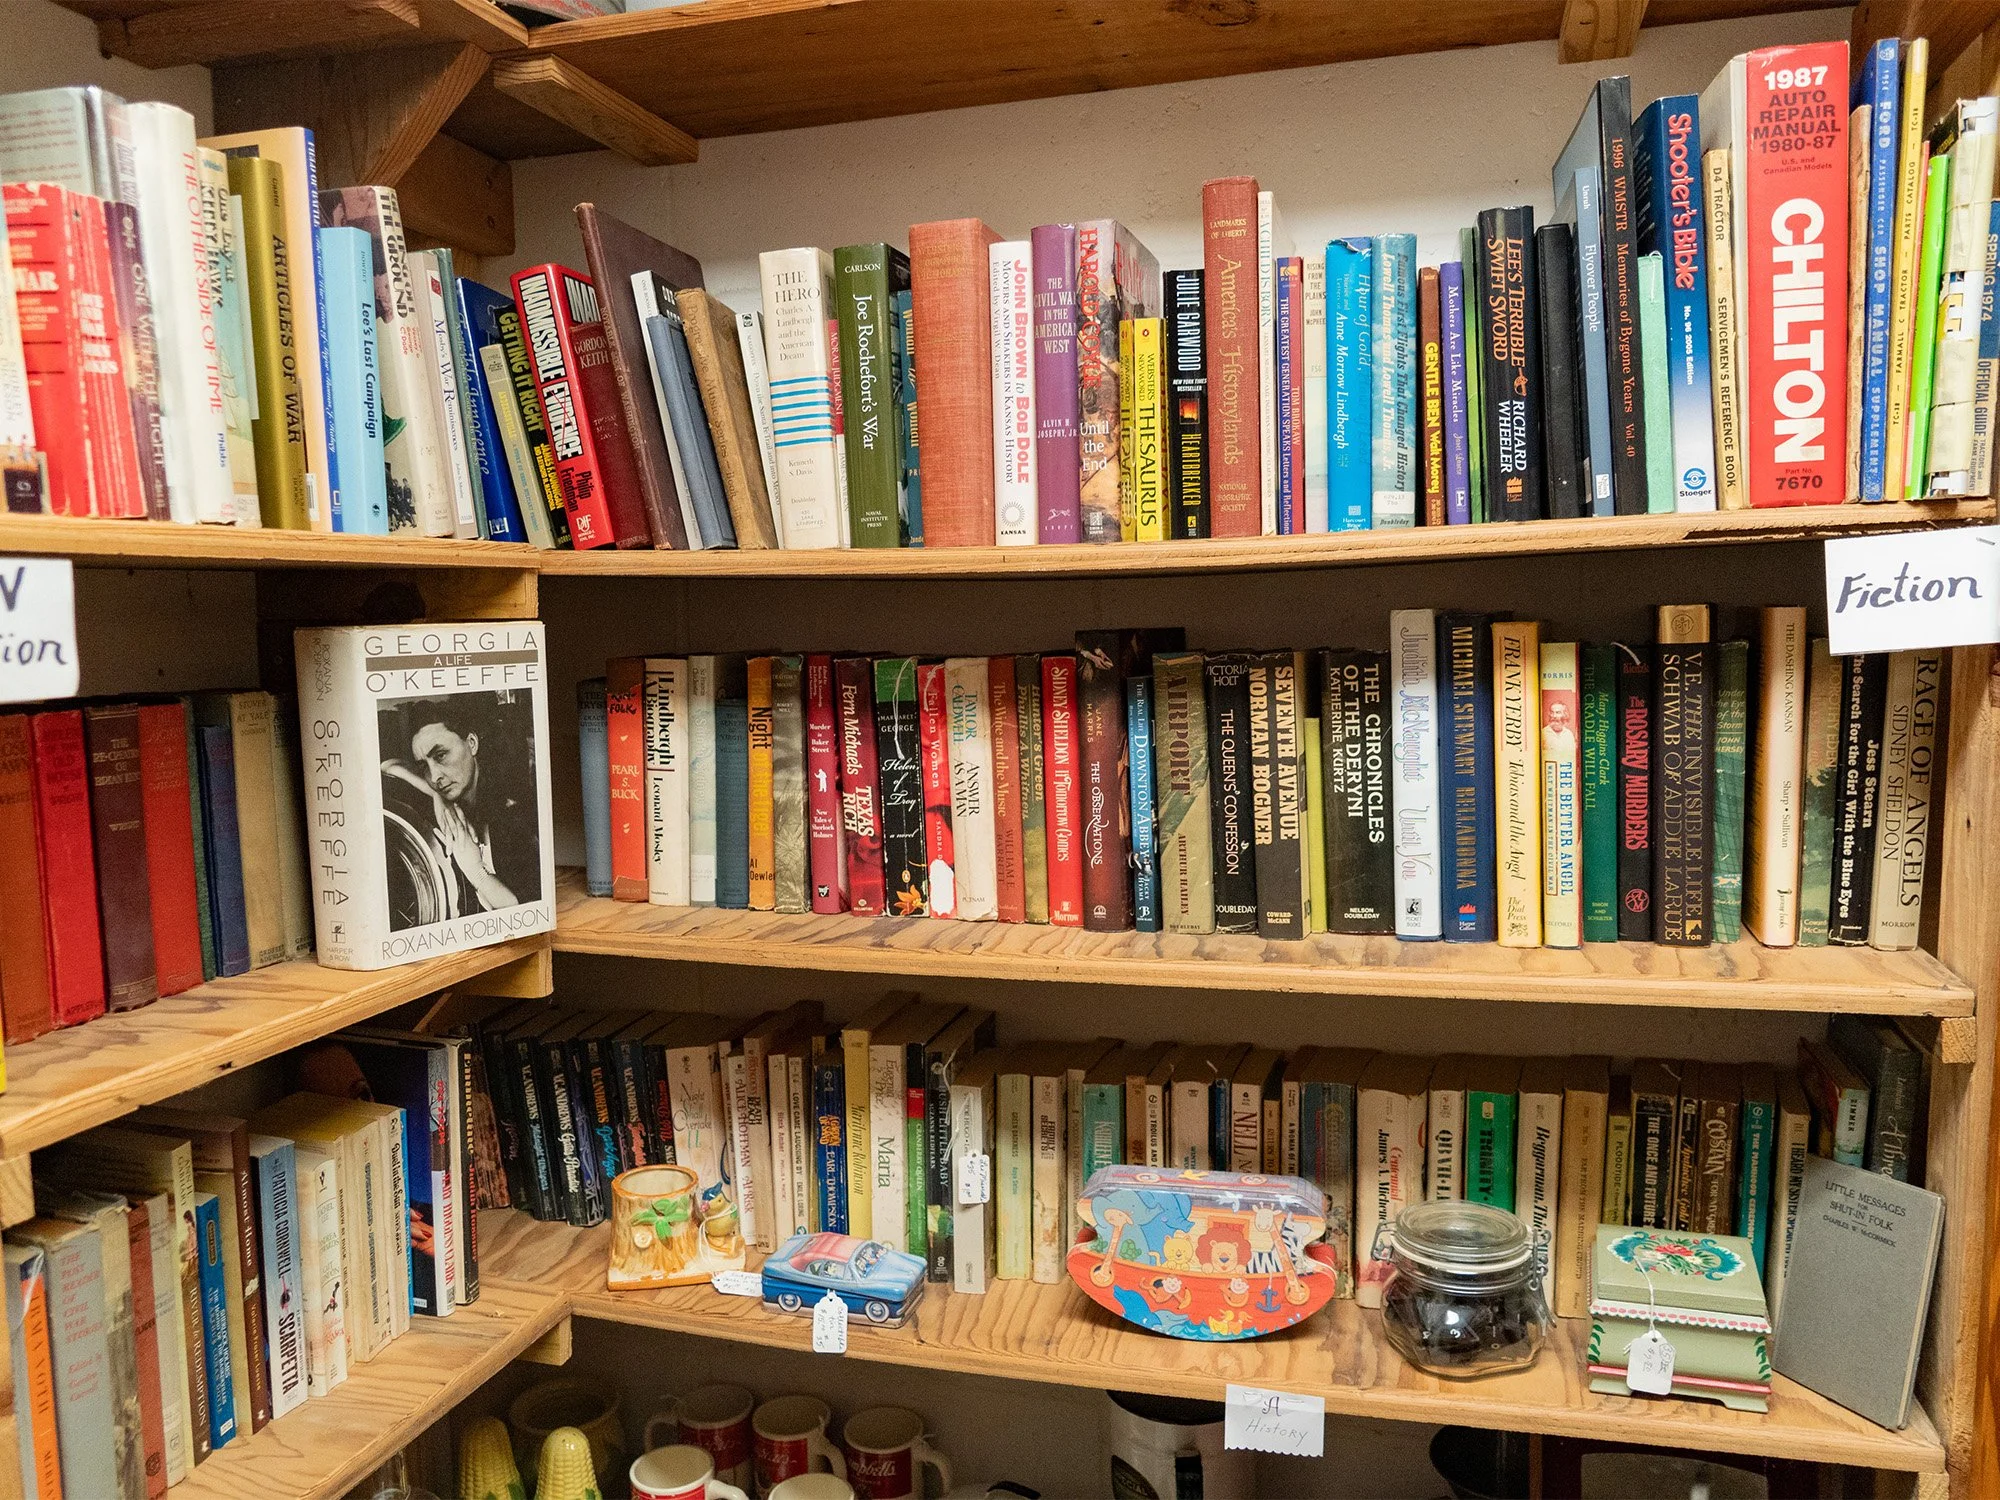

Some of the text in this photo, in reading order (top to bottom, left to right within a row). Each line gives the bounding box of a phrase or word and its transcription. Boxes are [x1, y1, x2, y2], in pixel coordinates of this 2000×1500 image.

[1760, 106, 1836, 122] REPAIR
[1765, 66, 1829, 90] 1987
[1769, 90, 1826, 107] AUTO
[1753, 122, 1840, 140] MANUAL
[1760, 136, 1835, 153] 1980-87
[1805, 163, 1832, 171] Models
[1669, 113, 1697, 288] Shooter's Bible
[1713, 168, 1725, 241] D4 TRACTOR
[773, 270, 808, 287] THE
[774, 288, 821, 303] HERO
[845, 263, 881, 273] CARLSON
[1489, 240, 1508, 360] SWIFT SWORD
[1506, 239, 1526, 367] LEE'S TERRIBLE
[1585, 244, 1599, 332] Flyover People
[1611, 138, 1635, 457] 1996 WMSTR Memories of Bygone Years Vol. 40
[273, 234, 300, 443] ARTICLES OF WAR
[1177, 275, 1201, 372] JULIE GARWOOD
[1447, 285, 1457, 327] Mothers
[1771, 198, 1826, 463] CHILTON
[361, 303, 376, 439] Lee's Last Campaign
[519, 276, 583, 461] INADMISSIBLE EVIDENCE
[853, 294, 878, 450] Joe Rochefort's War
[1013, 260, 1031, 484] JOHN BROWN to BOB DOLE
[1450, 353, 1459, 376] Like
[1684, 335, 1692, 354] 2005
[1685, 357, 1693, 385] Edition
[1333, 391, 1346, 449] Lindbergh
[1425, 343, 1441, 494] GENTLE BEN Walt Morey
[1451, 379, 1459, 423] Miracles
[1717, 297, 1736, 488] SERVICEMEN'S REFERENCE BOOK
[1140, 403, 1156, 526] THESAURUS
[1181, 433, 1201, 506] HEARTBREAKER
[1498, 399, 1512, 473] WHEELER
[1512, 400, 1527, 472] RICHARD
[1679, 488, 1711, 498] Stoeger
[1776, 475, 1822, 491] 7670
[1836, 562, 1982, 613] Fiction
[364, 632, 538, 655] GEORGIA
[365, 664, 539, 692] O'KEEFFE
[444, 655, 472, 666] LIFE
[658, 674, 675, 765] Lindbergh
[1167, 676, 1191, 795] AIRPORT
[1331, 667, 1343, 793] KATHERINE KURTZ
[1343, 665, 1363, 817] OF THE DERYNI
[1684, 693, 1702, 739] THE
[612, 765, 640, 775] PEARL
[622, 779, 630, 788] S.
[1249, 667, 1272, 845] NORMAN BOGNER
[1275, 666, 1299, 840] SEVENTH AVENUE
[1364, 664, 1385, 843] THE CHRONICLES
[1622, 709, 1648, 850] ROSARY MURDERS
[1863, 740, 1879, 829] Jess Stearn
[1882, 704, 1909, 861] SIDNEY SHELDON
[1900, 656, 1938, 906] RAGE OF ANGELS
[612, 790, 640, 800] BUCK
[1221, 709, 1239, 875] THE QUEEN'S CONFESSION
[1662, 653, 1682, 940] SCHWAB OF ADDIE LARUE
[1684, 746, 1702, 861] INVISIBLE
[1840, 676, 1863, 919] Search for the Girl With the Blue Eyes
[1559, 762, 1574, 896] THE BETTER ANGEL
[1684, 864, 1701, 918] LIFE
[1881, 920, 1916, 928] MORROW
[382, 907, 550, 961] ROXANA ROBINSON
[1686, 933, 1702, 941] TOR
[878, 1136, 895, 1188] Maria
[1643, 1116, 1660, 1227] THE ONCE AND FUTURE
[271, 1171, 289, 1279] PATRICIA CORNWELL
[1826, 1181, 1906, 1217] LITTLE MESSAGES
[1869, 1215, 1892, 1231] FOLK
[279, 1313, 298, 1394] SCARPETTA
